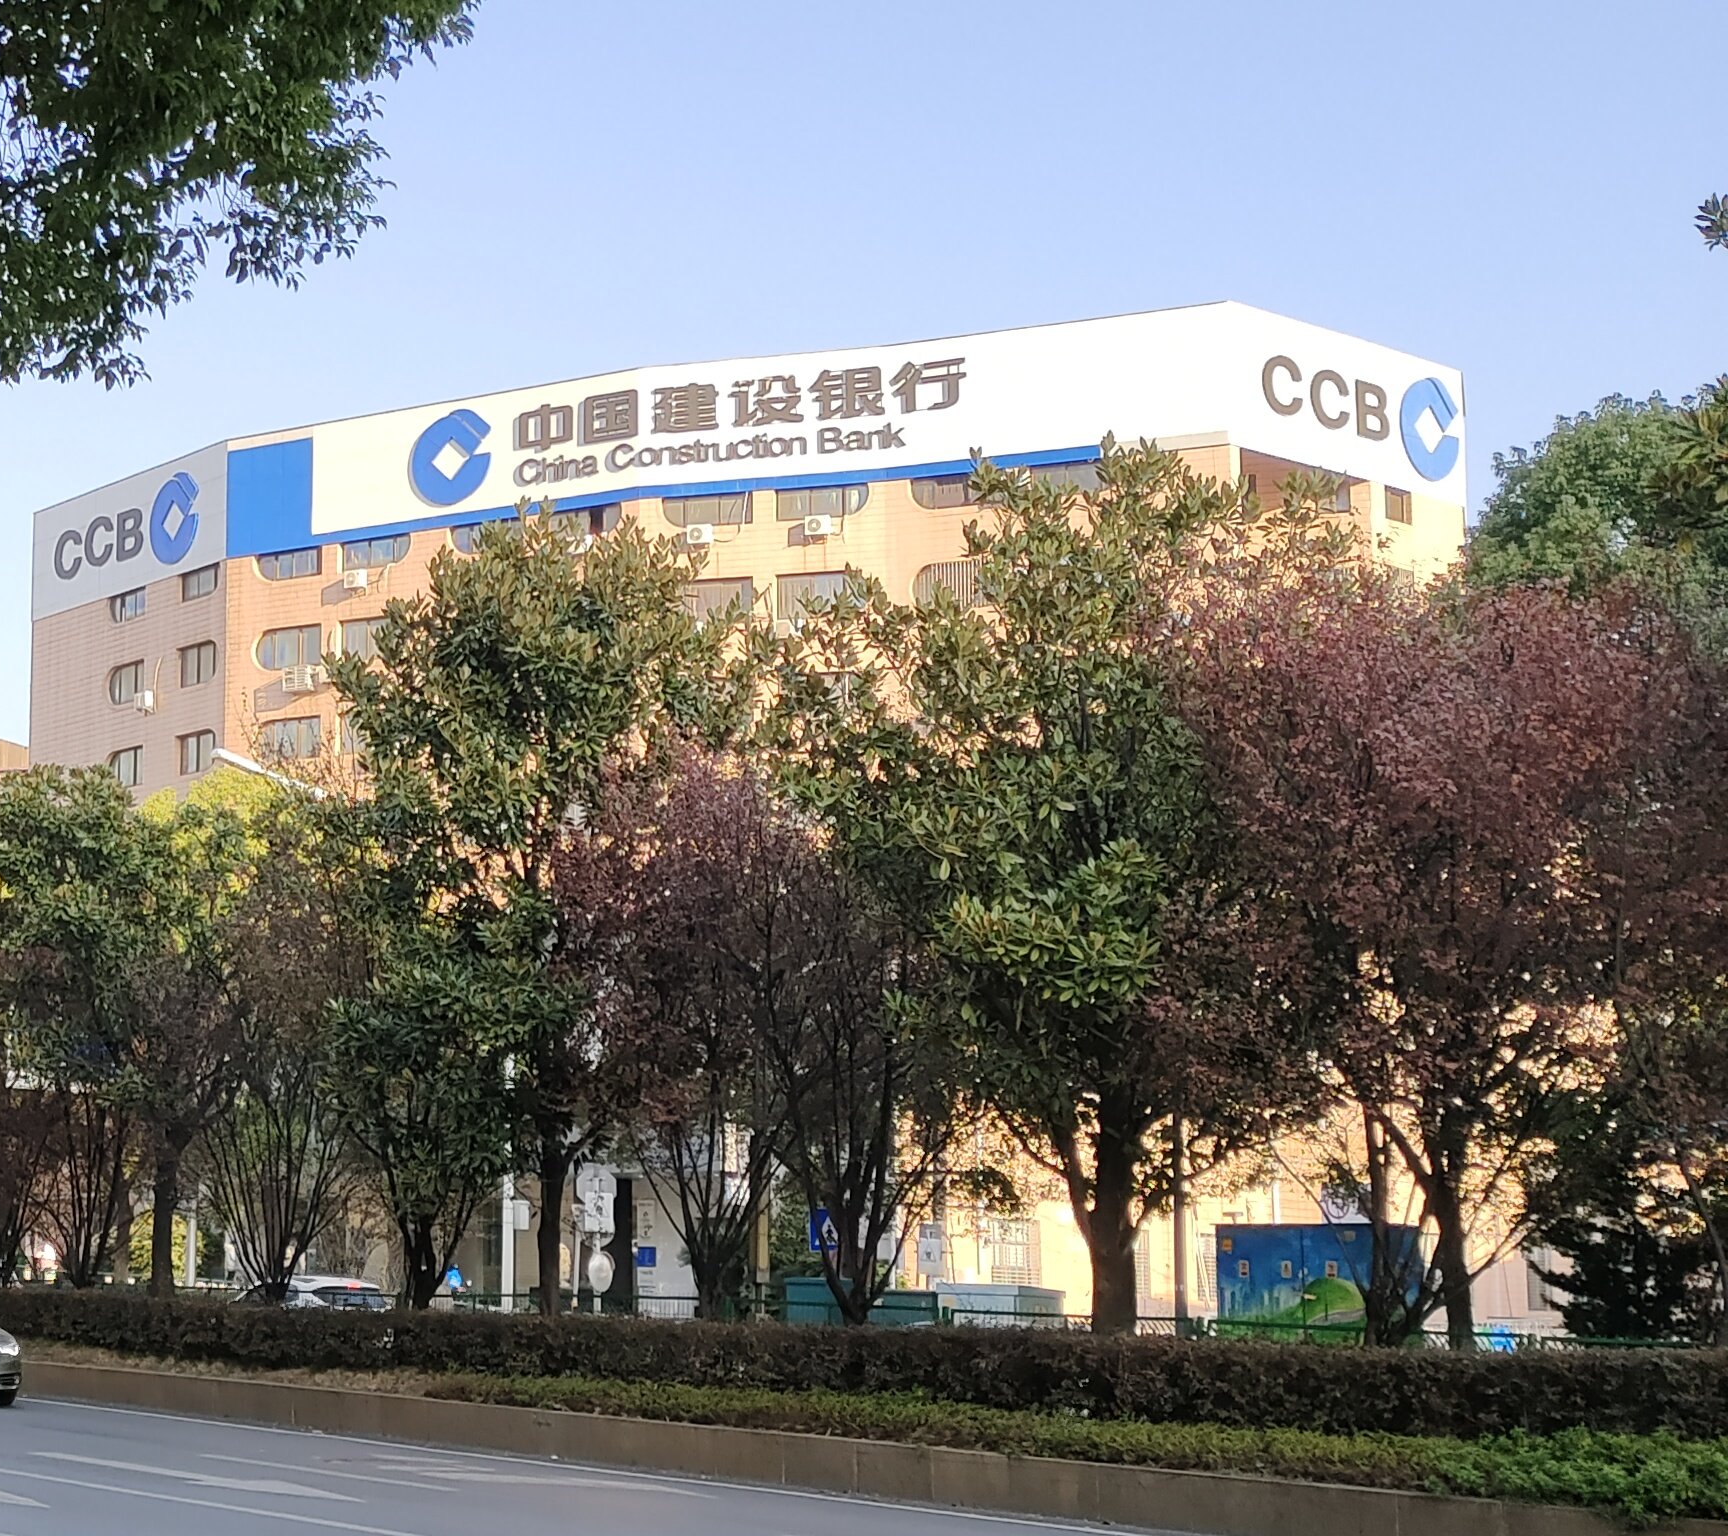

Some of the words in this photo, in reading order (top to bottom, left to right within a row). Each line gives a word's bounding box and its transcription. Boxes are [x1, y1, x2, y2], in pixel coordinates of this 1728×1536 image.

[514, 357, 966, 453] 中国建设银行
[1262, 355, 1390, 441] CCB
[514, 454, 599, 487] China
[605, 432, 807, 472] Construction
[817, 422, 906, 454] Bank
[54, 508, 144, 580] CCB
